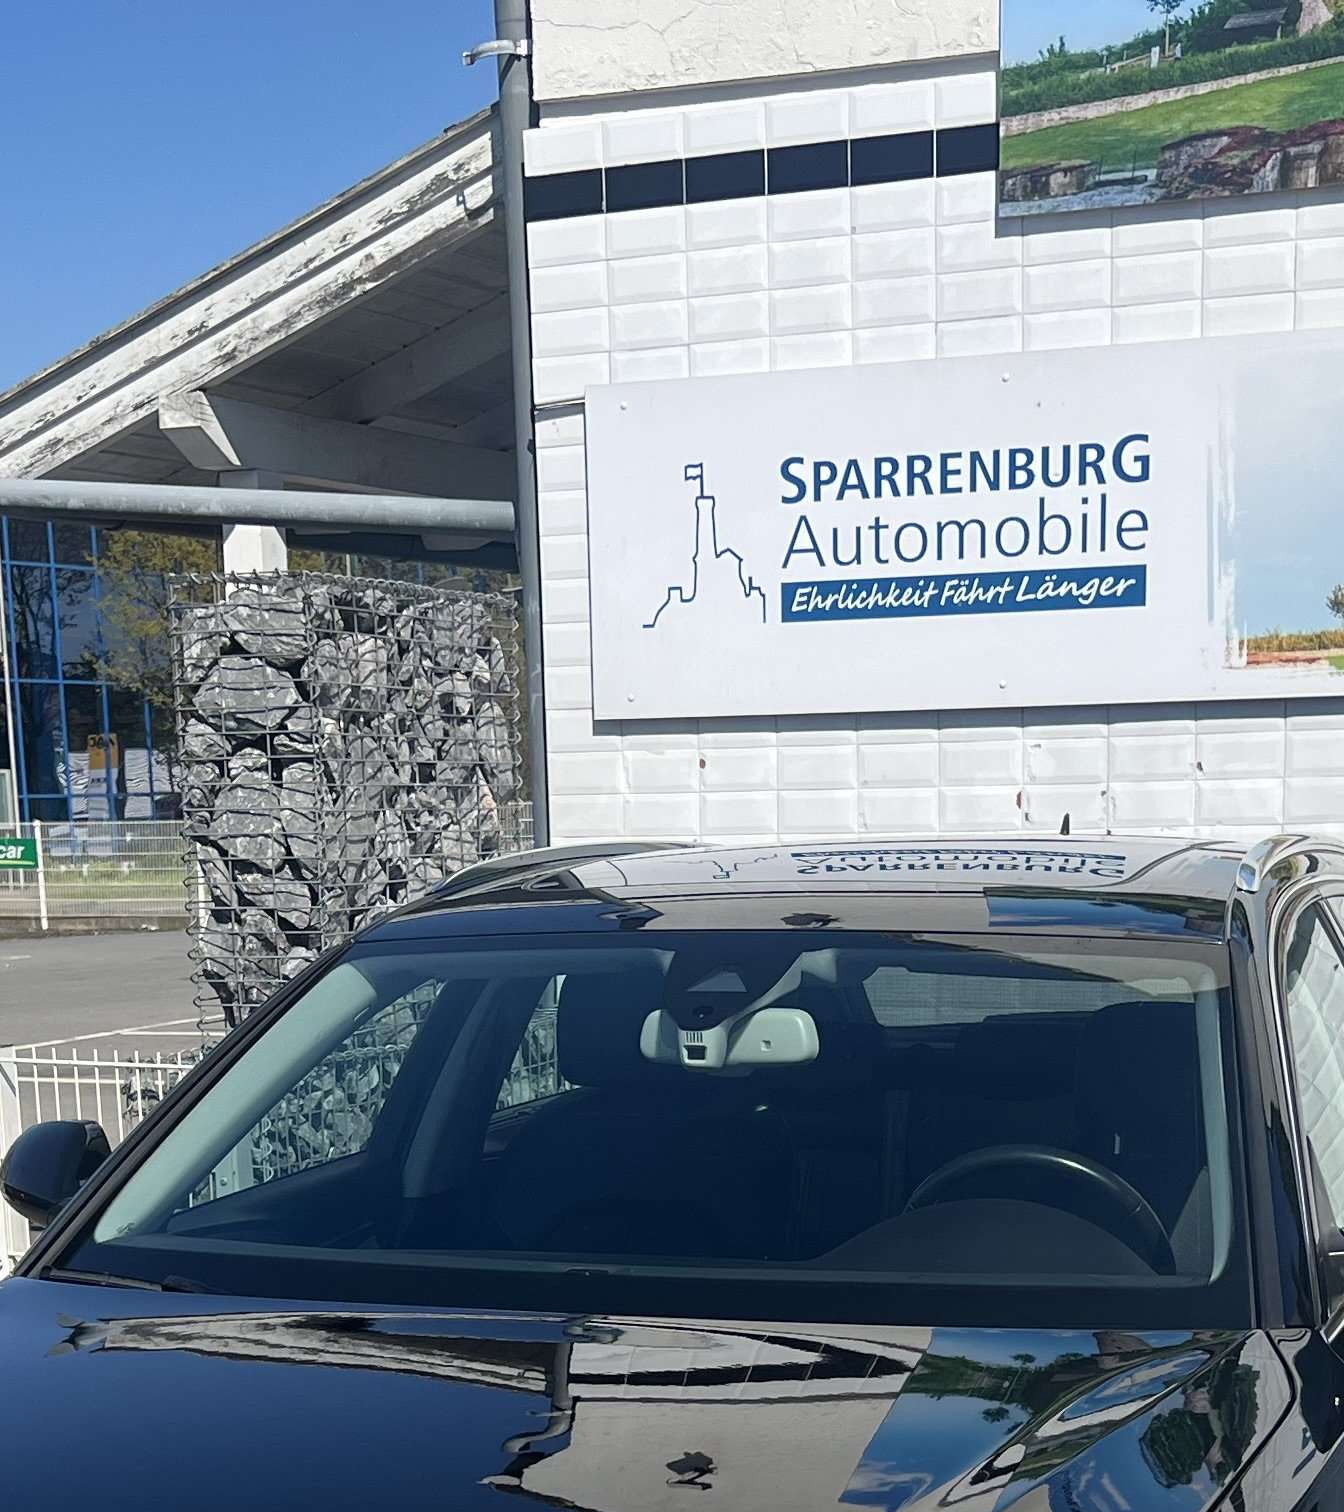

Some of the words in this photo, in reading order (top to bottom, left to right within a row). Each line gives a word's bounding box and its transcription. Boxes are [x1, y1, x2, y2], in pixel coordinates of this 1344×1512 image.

[780, 434, 1150, 504] SPARRENBURG
[782, 493, 1148, 568] Automobile
[792, 579, 939, 612] Ehrlichkeit
[940, 578, 1015, 606] Fährt
[1016, 575, 1136, 605] Länger
